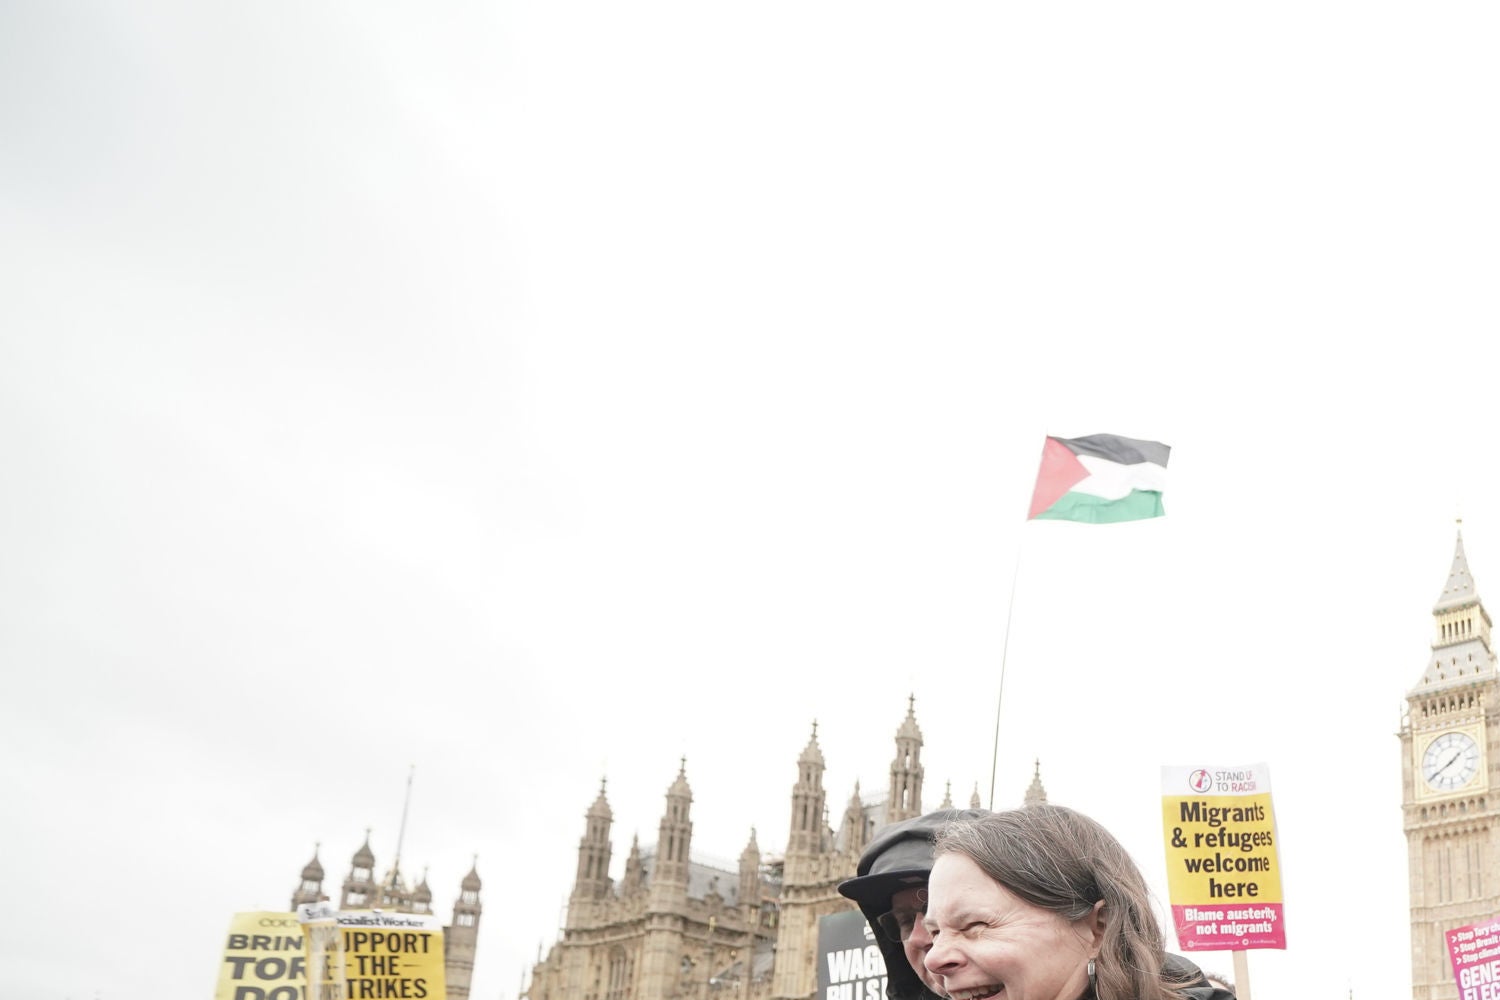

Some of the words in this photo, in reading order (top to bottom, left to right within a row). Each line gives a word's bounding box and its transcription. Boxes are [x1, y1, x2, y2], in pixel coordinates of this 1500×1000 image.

[1215, 771, 1244, 781] STAND
[1216, 782, 1229, 792] TO
[1180, 801, 1265, 827] Migrants
[1171, 827, 1188, 848] &
[1194, 827, 1272, 852] refugees
[1184, 852, 1270, 873] welcome
[1209, 878, 1258, 898] here
[1184, 908, 1224, 921] Blame
[1196, 923, 1217, 935] not
[1220, 921, 1272, 936] migrants
[1457, 929, 1474, 942] Stop
[227, 933, 304, 951] BRIN
[1459, 941, 1476, 953] Stop
[827, 945, 887, 984] WAG
[1462, 951, 1479, 963] Stop
[355, 955, 400, 976] THE
